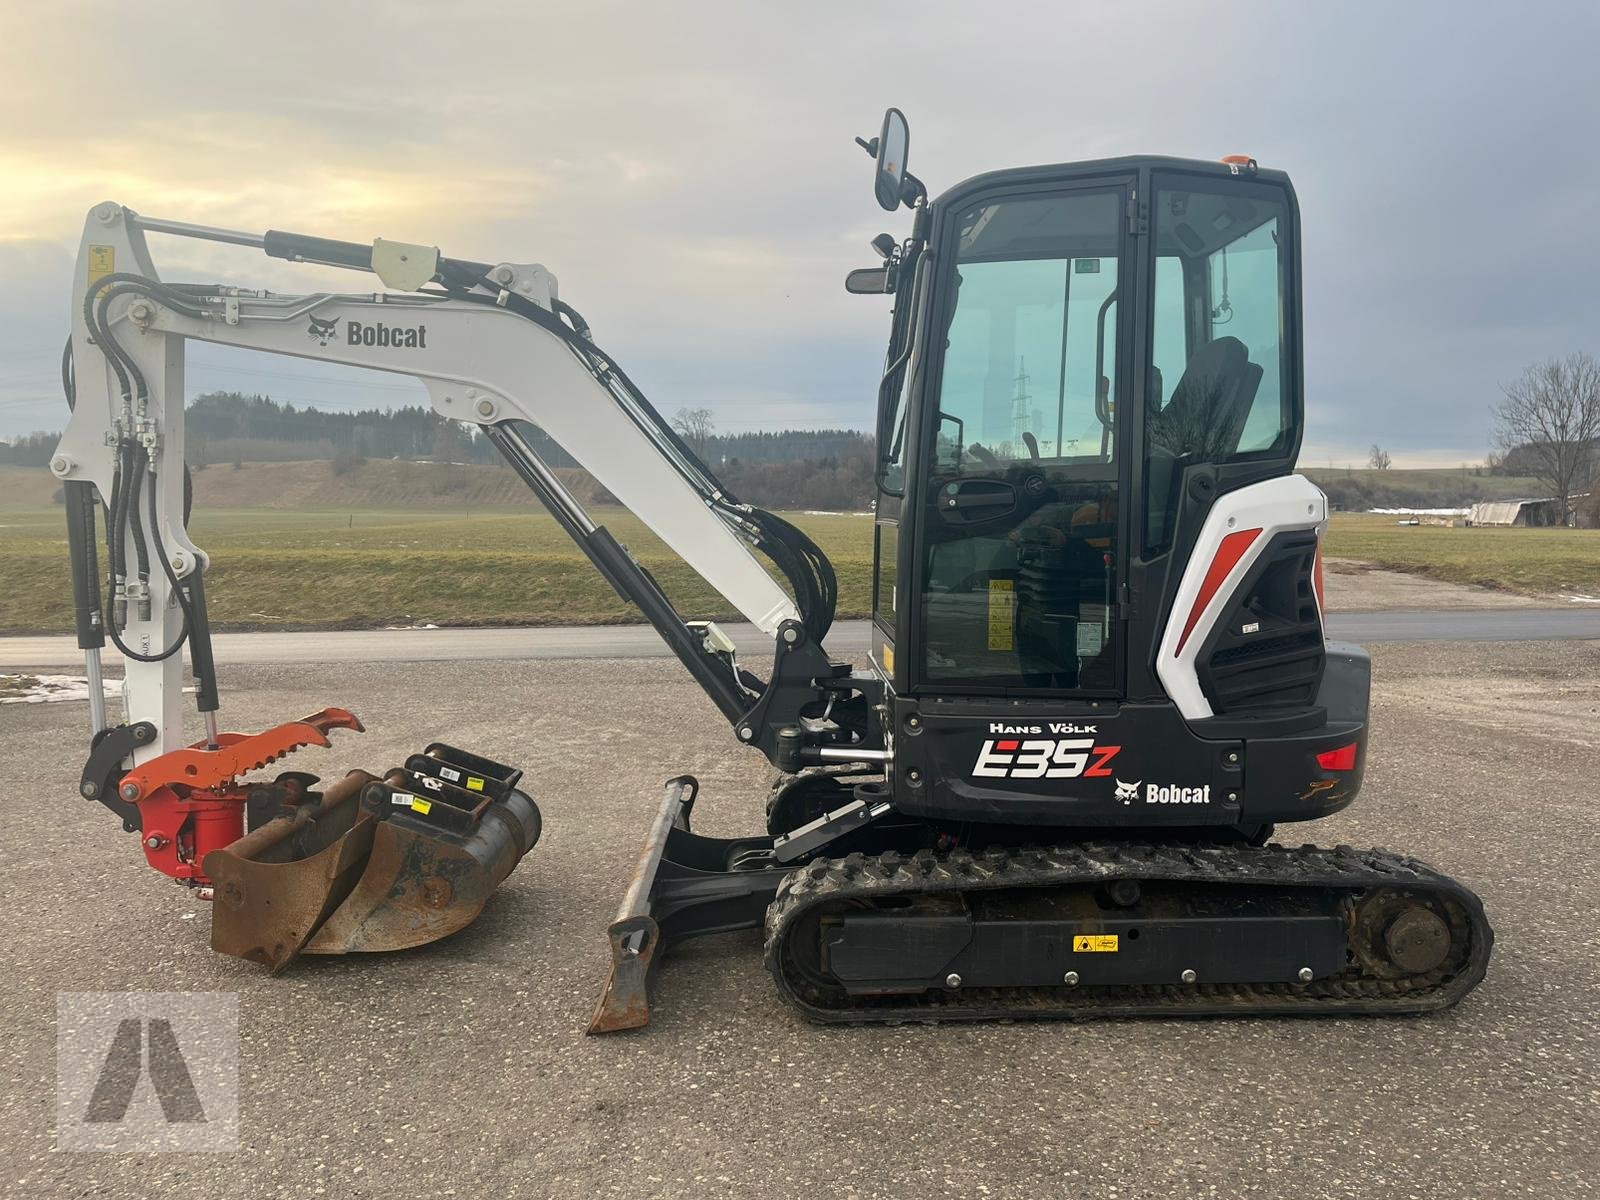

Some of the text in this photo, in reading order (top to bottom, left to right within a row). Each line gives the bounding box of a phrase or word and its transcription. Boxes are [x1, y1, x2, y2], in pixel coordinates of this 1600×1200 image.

[347, 321, 426, 348] Bobcat
[989, 723, 1042, 734] HANS
[1146, 783, 1211, 804] Bobcat
